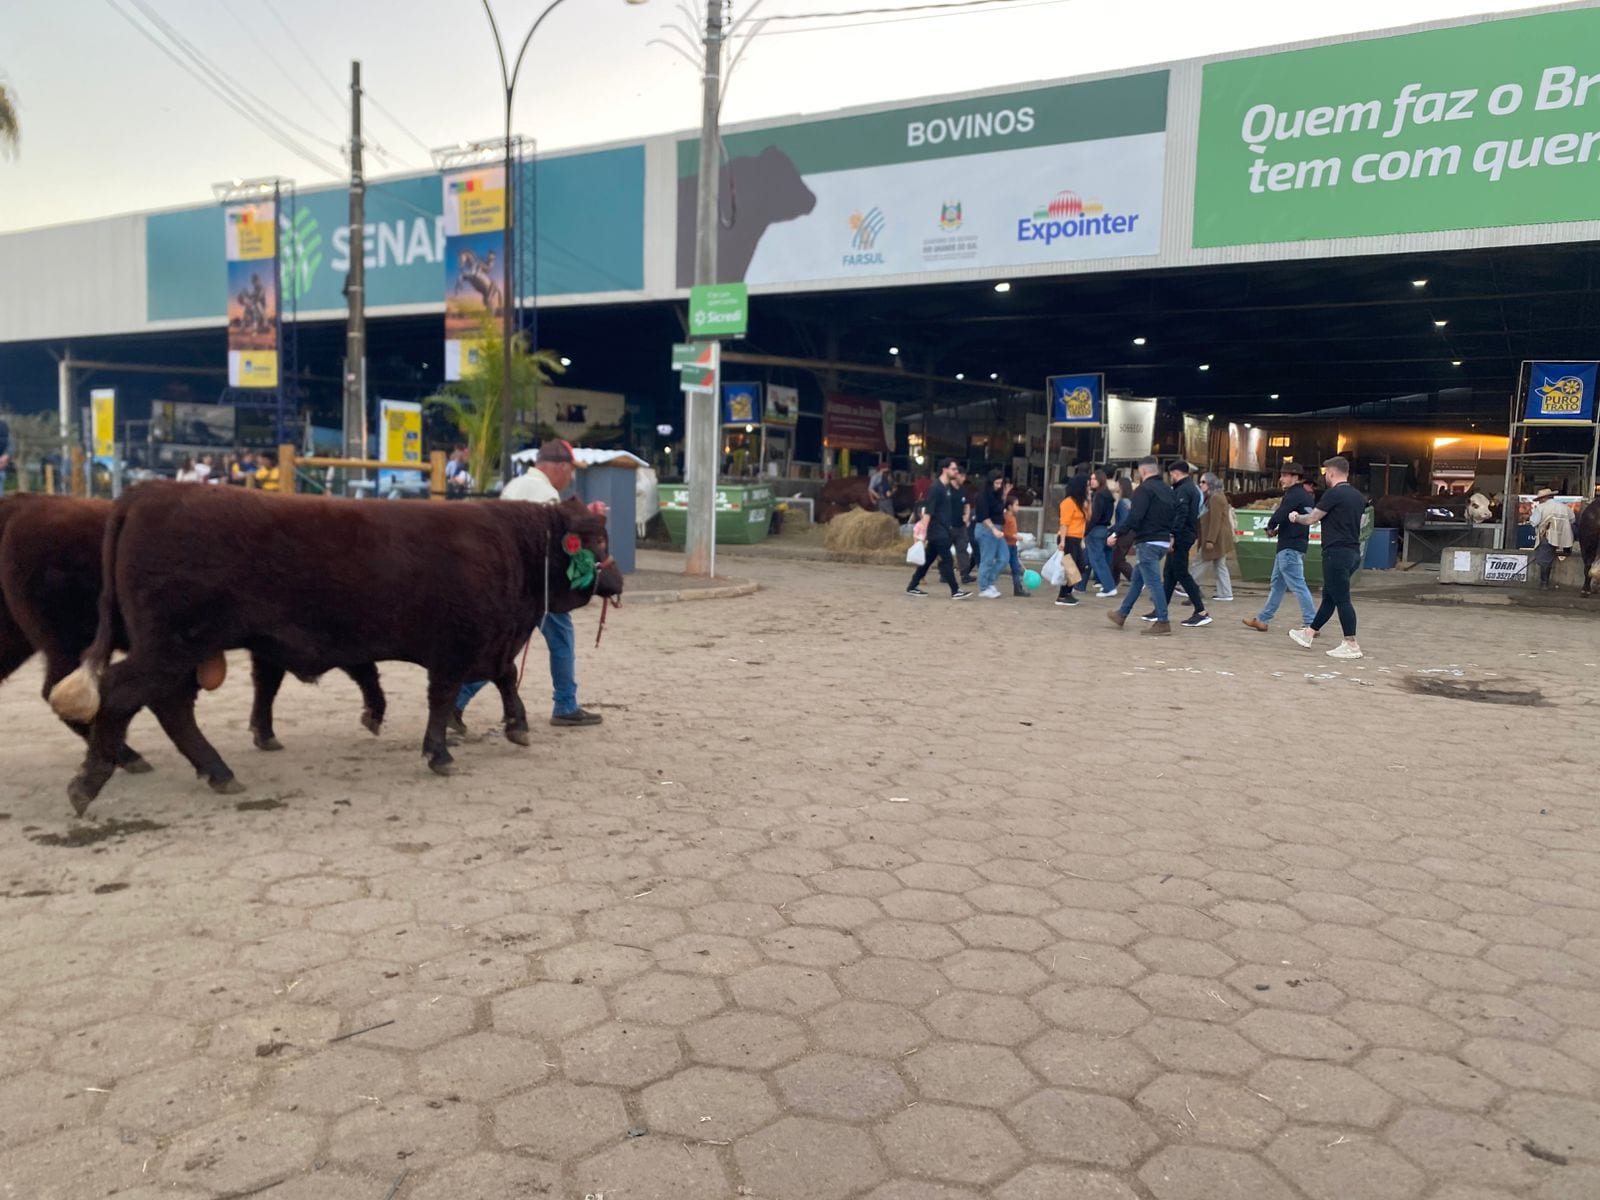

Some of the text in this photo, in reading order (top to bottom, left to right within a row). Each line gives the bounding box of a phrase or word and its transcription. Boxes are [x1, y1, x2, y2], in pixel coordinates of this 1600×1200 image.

[1241, 100, 1382, 154] Quem
[1382, 83, 1479, 138] faz
[1488, 83, 1524, 116] o
[906, 106, 1036, 147] BOVINOS
[1248, 157, 1342, 193] tem
[1351, 144, 1462, 183] com
[1017, 212, 1140, 245] Expointer
[841, 252, 886, 267] FARSUL
[707, 309, 742, 322] Sicredi
[1544, 403, 1579, 411] TRATO
[1545, 395, 1579, 404] PURO
[1490, 561, 1517, 570] TORRI
